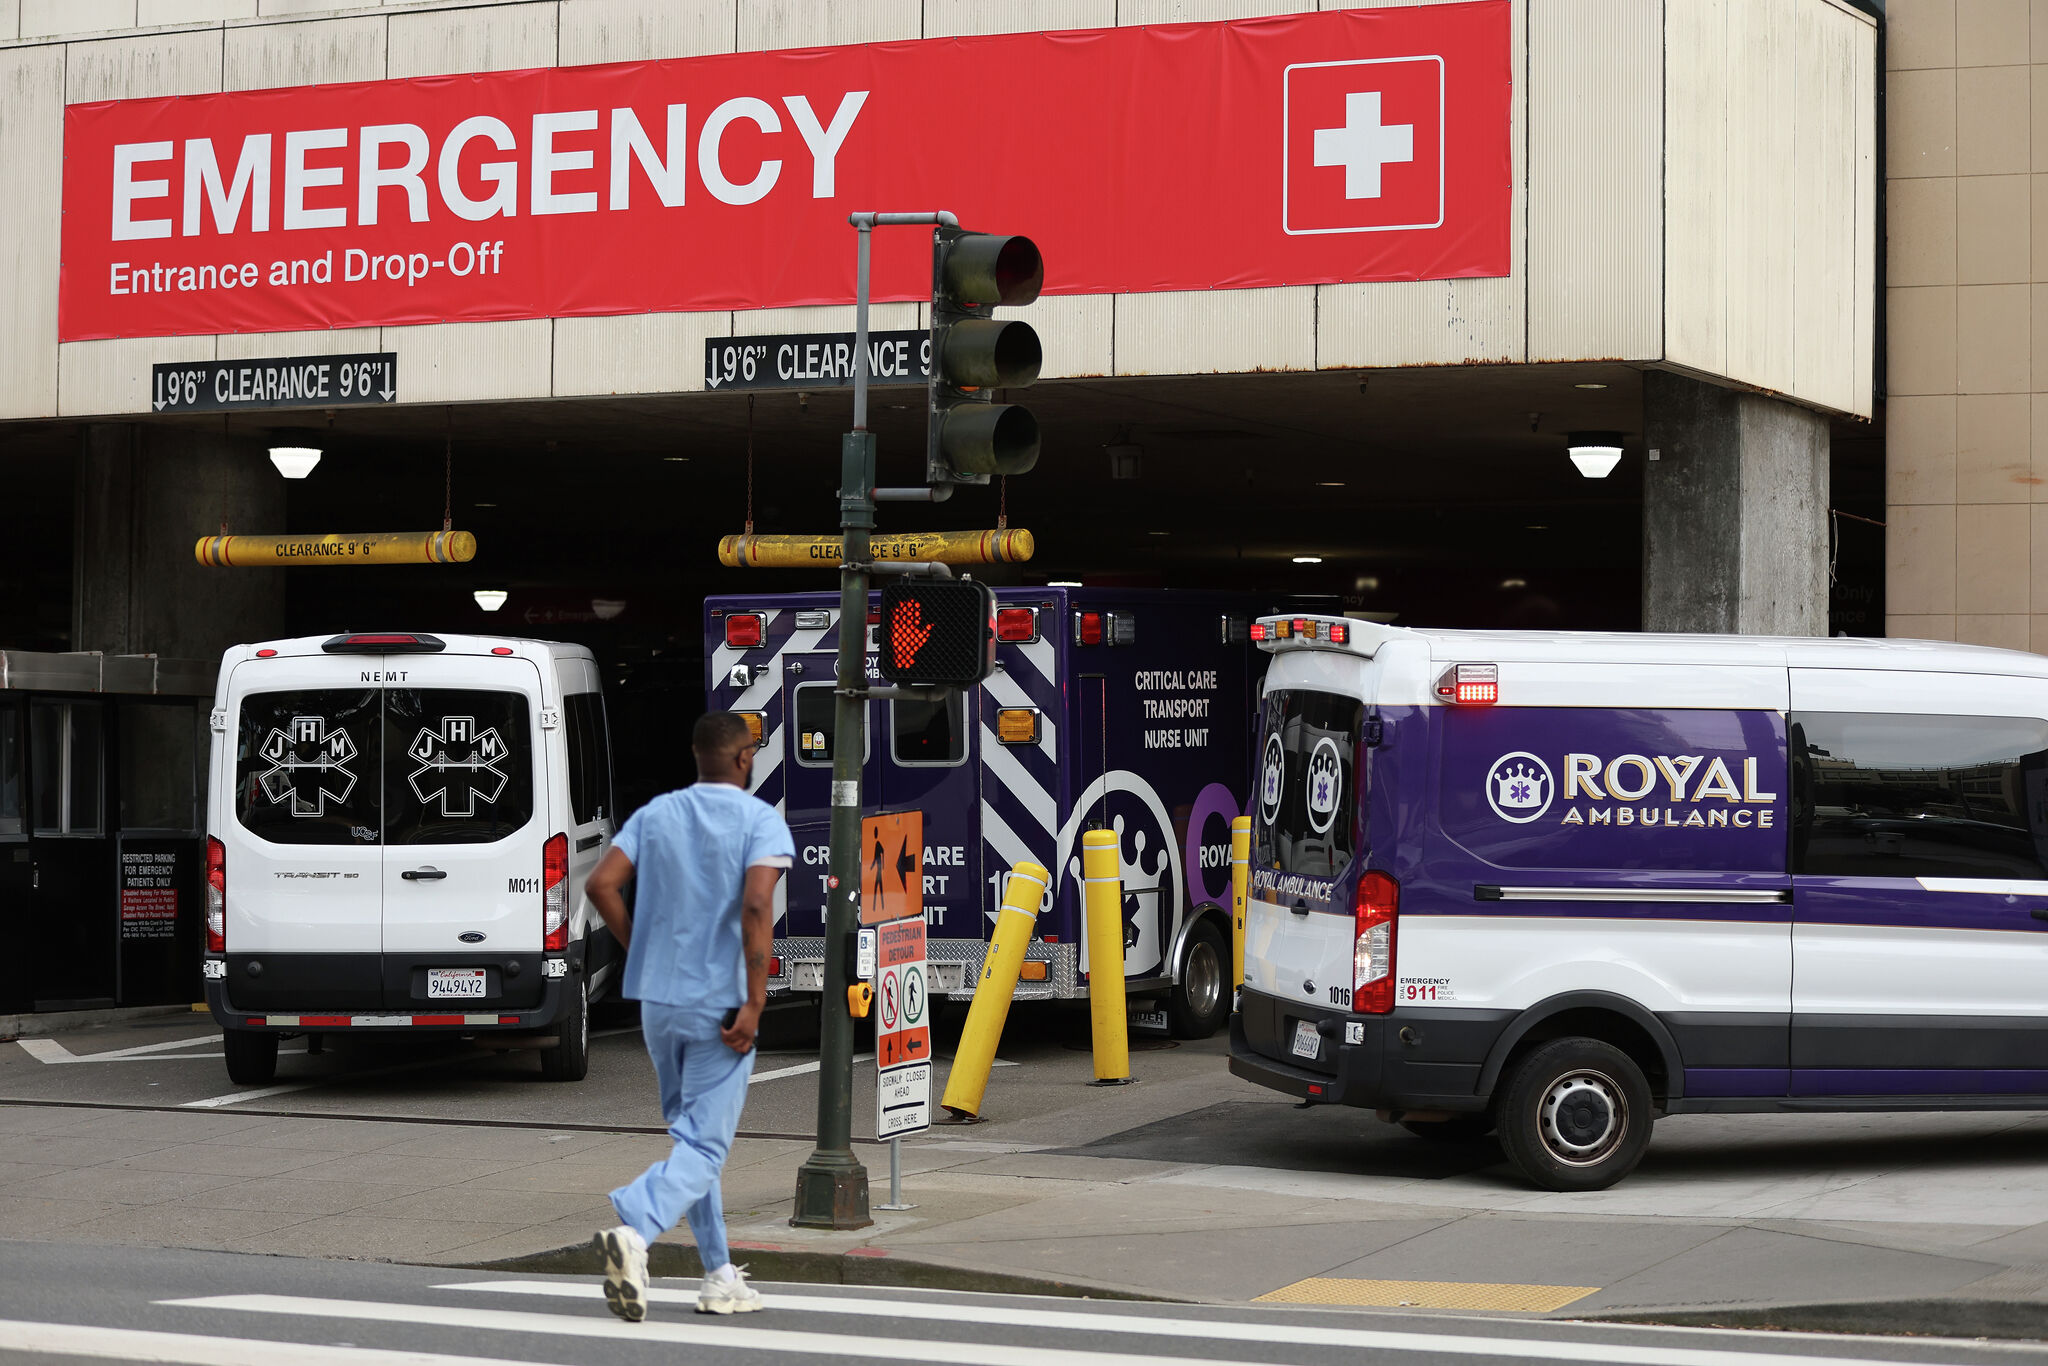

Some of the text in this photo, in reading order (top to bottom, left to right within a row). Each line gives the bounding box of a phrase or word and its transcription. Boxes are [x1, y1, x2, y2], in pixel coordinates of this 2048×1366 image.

[111, 90, 870, 242] EMERGENCY
[110, 240, 504, 296] Entrance and Drop-Off
[215, 364, 330, 403] CLEARANCE
[276, 543, 344, 557] CLEARANCE
[810, 544, 888, 559] CLEACE
[360, 671, 408, 682] NEMT
[1135, 670, 1217, 690] CRITICAL CARE
[1143, 699, 1210, 719] TRANSPORT
[1145, 728, 1209, 749] NURSE UNIT
[1564, 753, 1777, 803] ROYAL
[1561, 806, 1774, 828] AMBULANCE
[122, 853, 176, 863] RESTRICTED PARKING
[922, 846, 965, 866] ARE
[1200, 844, 1232, 868] ROYA
[125, 866, 173, 875] FOR EMERGENCY
[127, 878, 171, 887] PATIENTS ONLY
[508, 878, 539, 893] M011
[1254, 870, 1334, 902] ROYAL AMBULANCE
[882, 927, 922, 945] PEDESTRIAN
[889, 945, 914, 962] DETOUR
[432, 980, 482, 993] 94494Y2
[1407, 985, 1437, 1000] 911
[1329, 986, 1350, 1006] 1016
[906, 1070, 927, 1082] CLOSED
[894, 1086, 910, 1098] AHEAD
[904, 1113, 917, 1125] HERE
